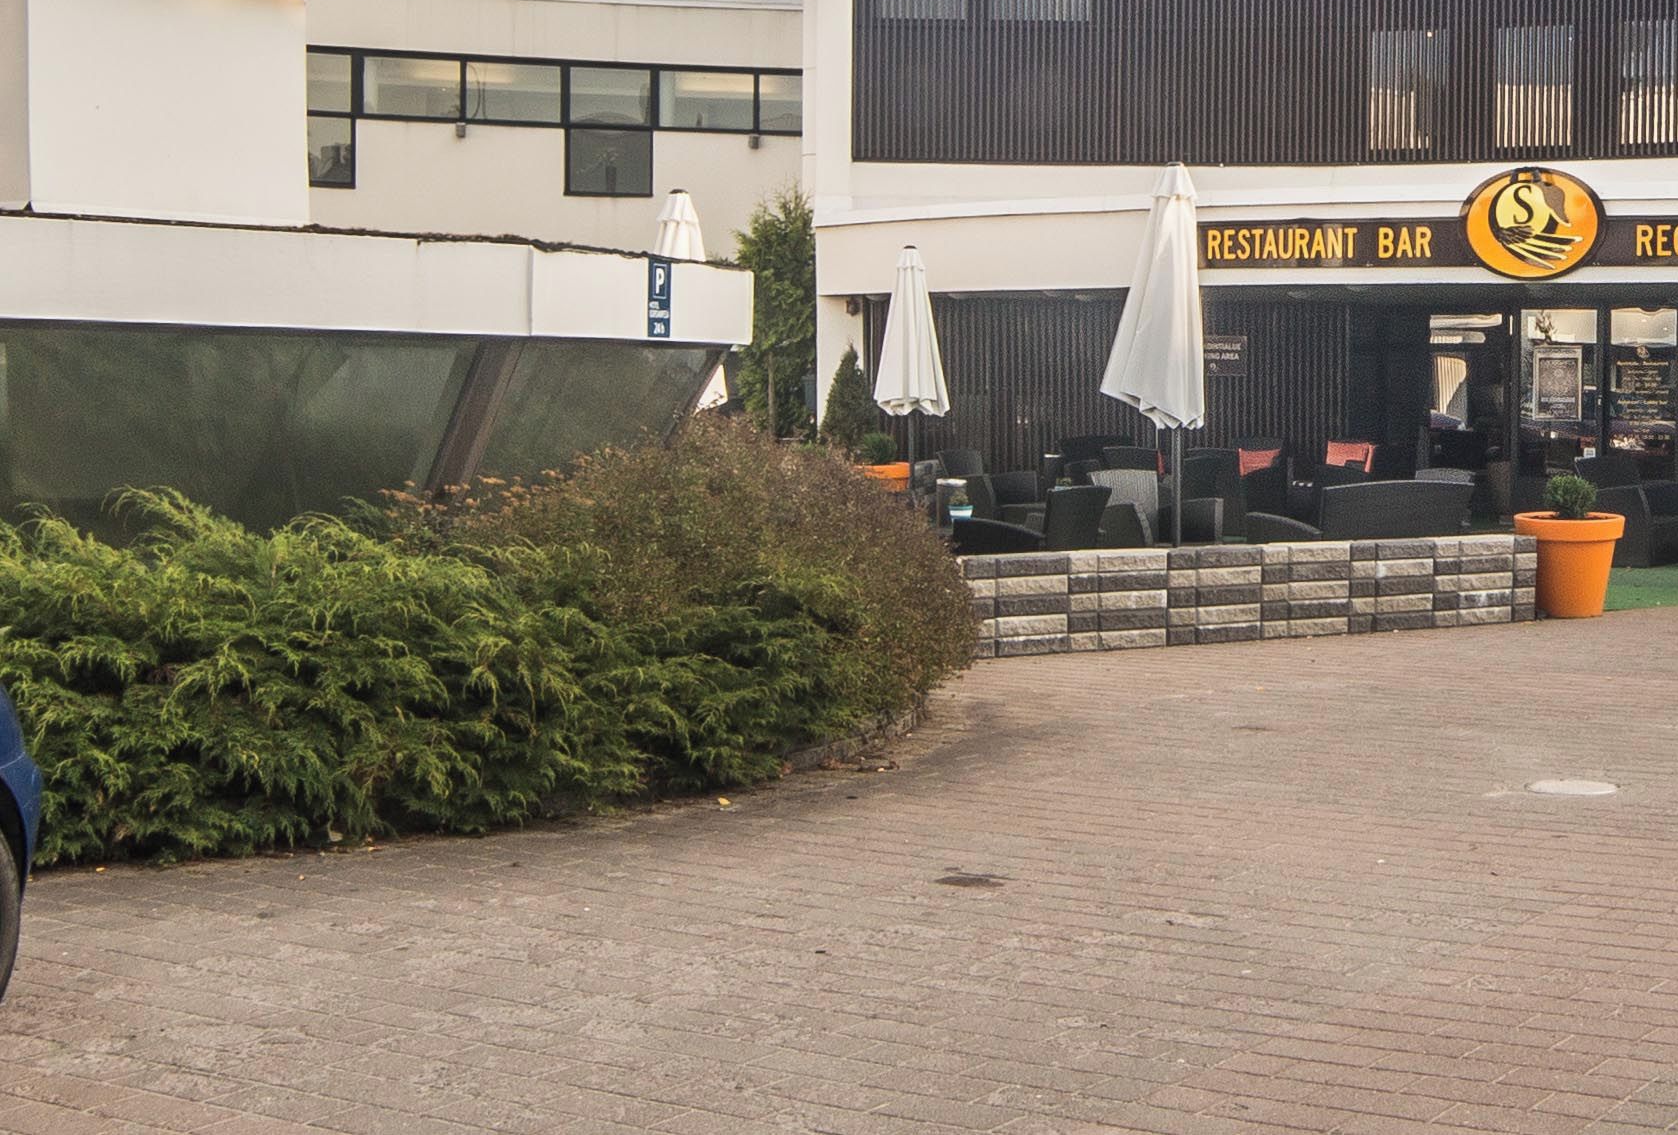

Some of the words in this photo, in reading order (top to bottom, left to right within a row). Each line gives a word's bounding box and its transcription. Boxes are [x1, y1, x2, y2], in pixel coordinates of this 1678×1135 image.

[1512, 184, 1534, 225] S
[1206, 226, 1358, 260] RESTAURANT
[1377, 226, 1433, 260] BAR
[655, 267, 665, 295] P
